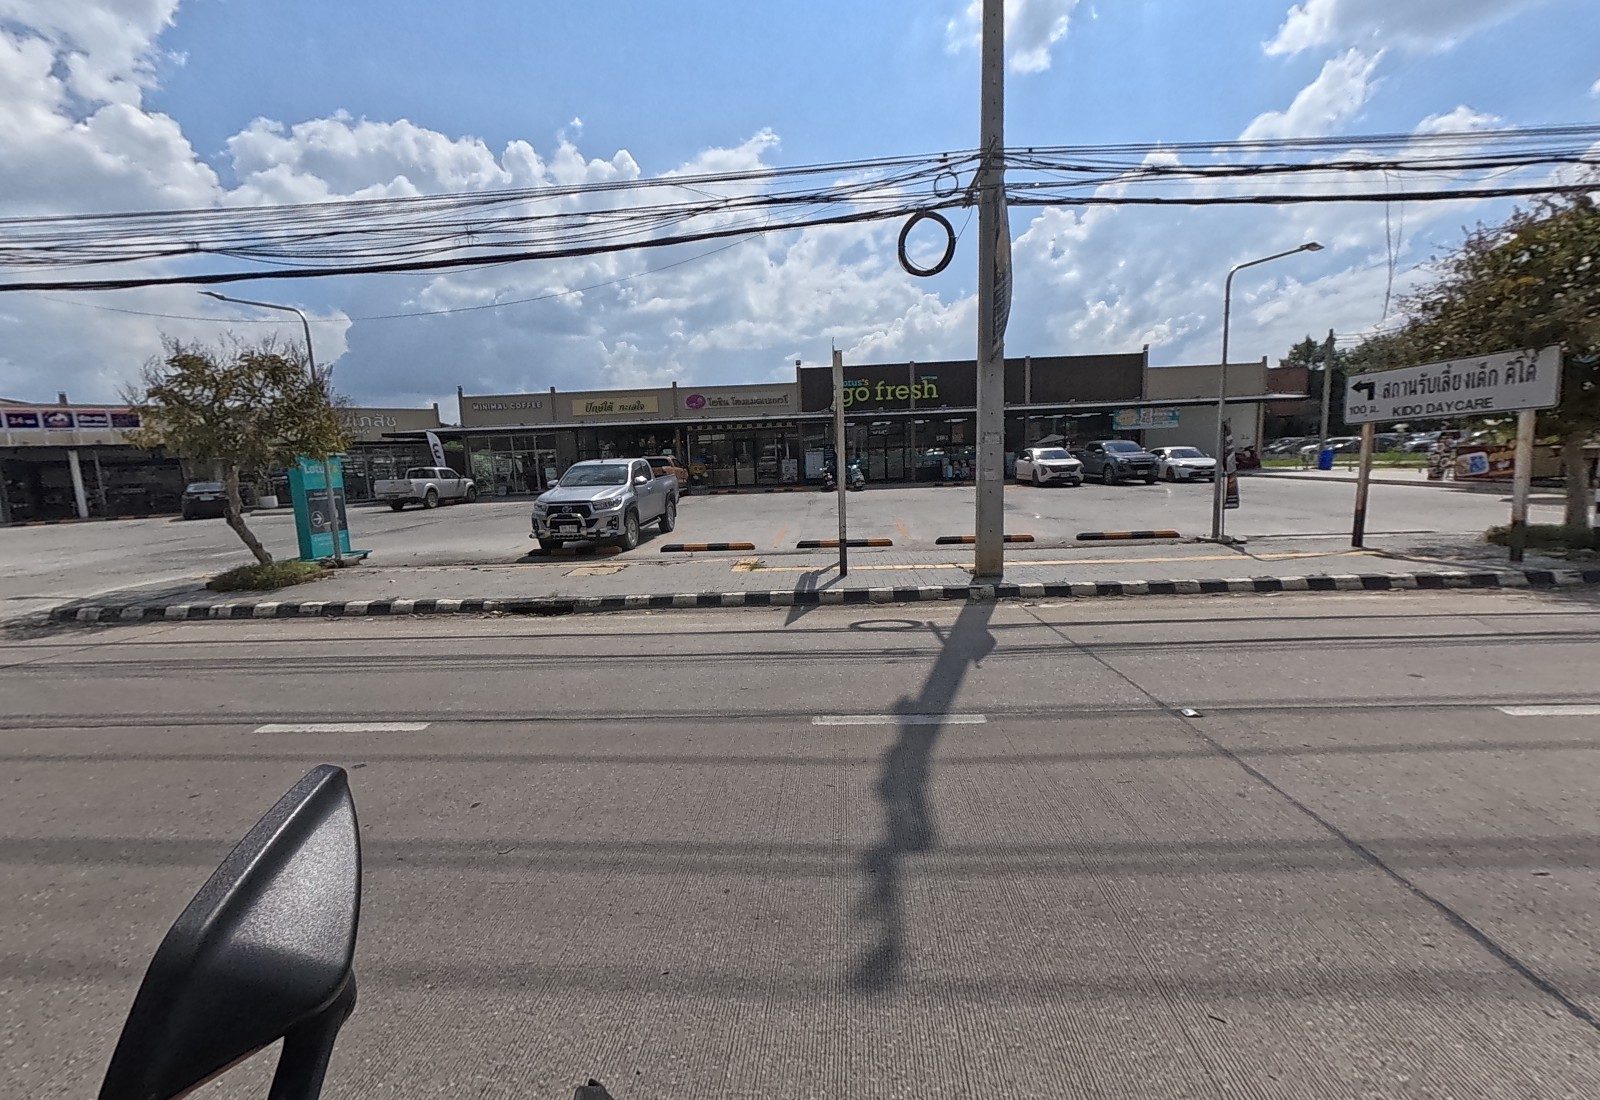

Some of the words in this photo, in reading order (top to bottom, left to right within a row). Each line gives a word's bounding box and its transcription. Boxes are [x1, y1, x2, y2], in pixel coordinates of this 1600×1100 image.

[1383, 361, 1499, 400] สถานรับเลี้ยงเด็ก
[843, 386, 870, 407] go
[875, 380, 939, 401] fresh
[472, 402, 508, 411] MINIMAL
[510, 401, 543, 410] COFFEE
[1349, 404, 1367, 415] 100
[1392, 404, 1423, 417] KIDO
[1426, 397, 1494, 414] DAYCARE
